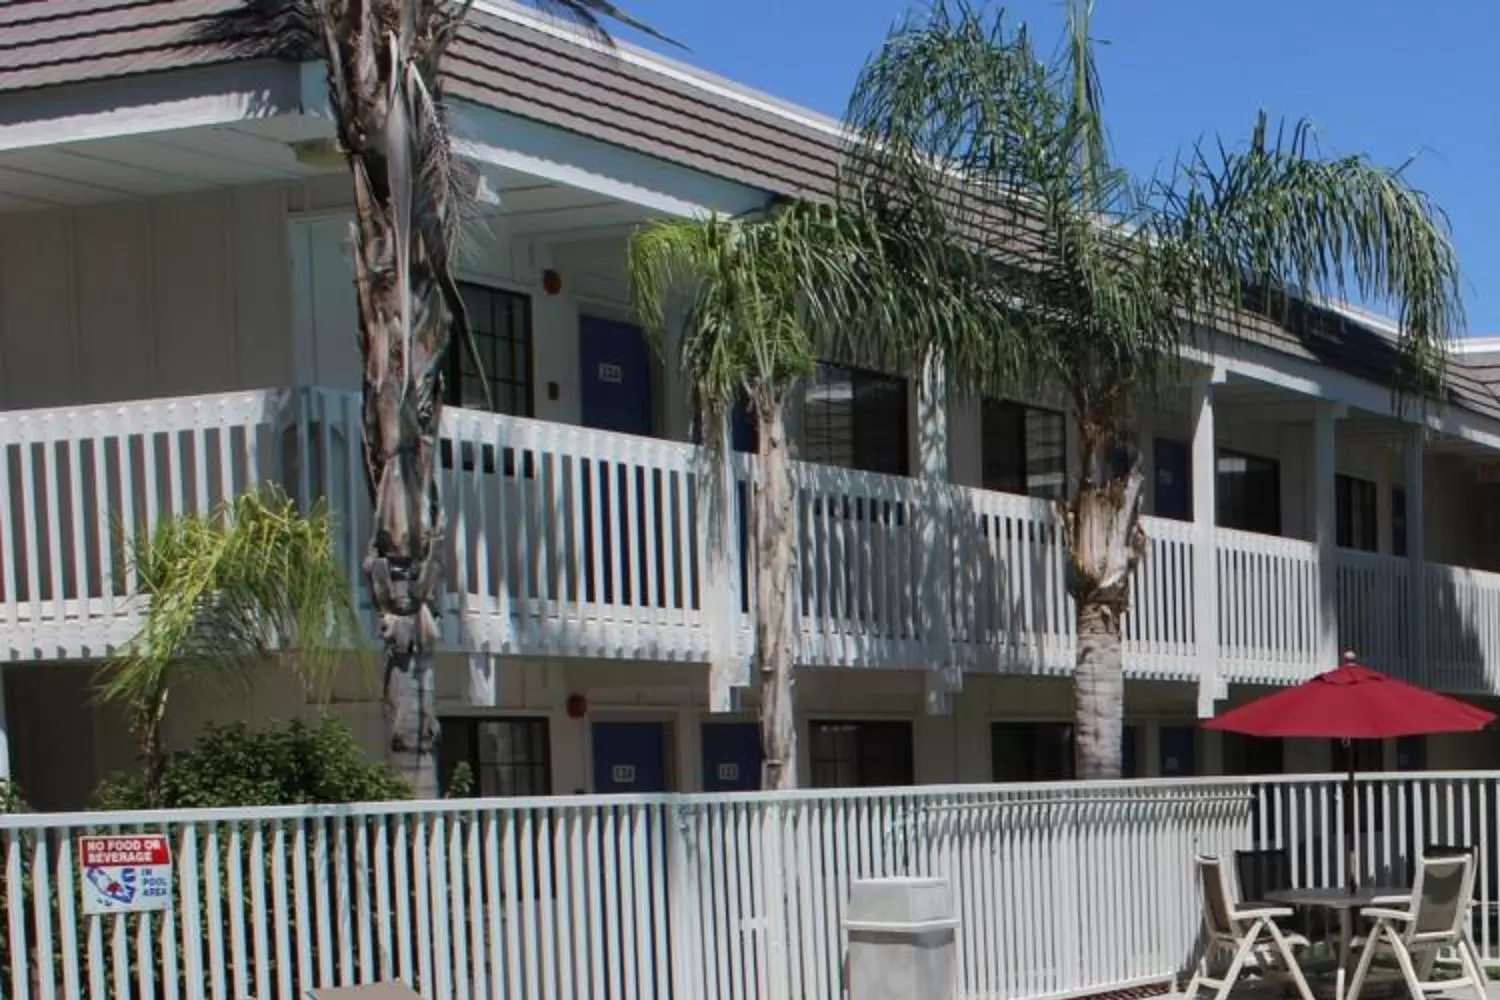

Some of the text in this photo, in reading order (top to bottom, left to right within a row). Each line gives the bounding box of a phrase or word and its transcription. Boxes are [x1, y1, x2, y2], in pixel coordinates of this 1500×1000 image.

[87, 839, 161, 852] NO FOOD OR
[87, 851, 153, 863] BEVERAGE
[141, 867, 153, 876] IN
[143, 877, 167, 886] POOL
[143, 887, 167, 897] AREA
